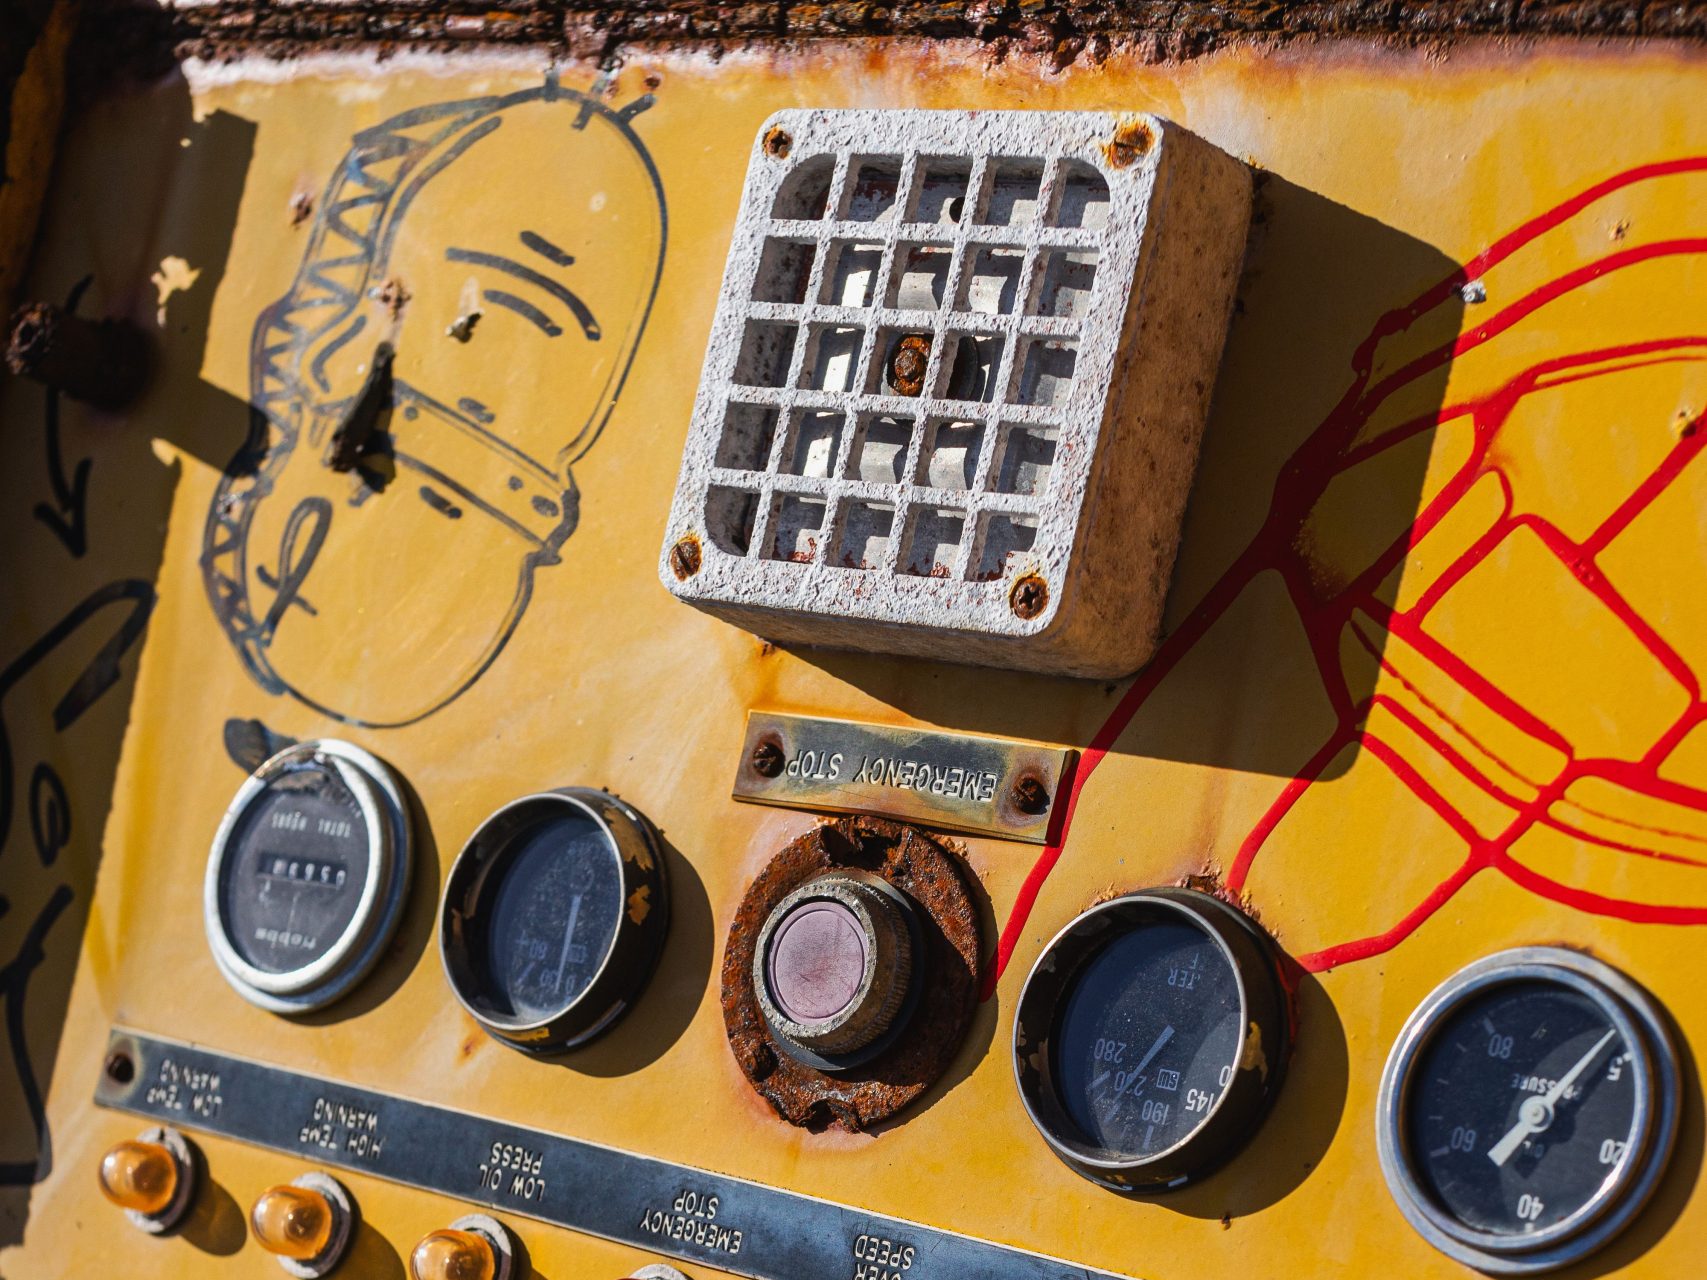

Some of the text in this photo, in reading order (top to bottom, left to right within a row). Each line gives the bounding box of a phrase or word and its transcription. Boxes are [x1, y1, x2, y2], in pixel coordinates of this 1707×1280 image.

[786, 750, 998, 802] EMERGENCY STOP
[1093, 1038, 1127, 1064] 280
[1487, 1034, 1514, 1060] 80
[160, 1058, 220, 1092] WARNING
[1511, 1073, 1582, 1100] PRSSURE
[147, 1085, 222, 1118] LOW TEMP
[313, 1098, 377, 1131] WARNING
[1142, 1101, 1170, 1125] 190
[1185, 1088, 1215, 1114] 145
[299, 1124, 383, 1158] HIGH TEMP
[1452, 1126, 1476, 1153] 60
[1600, 1139, 1626, 1166] 20
[491, 1142, 544, 1175] PRESS
[479, 1164, 545, 1201] LOW OIL
[674, 1191, 718, 1220] STOP
[1517, 1194, 1544, 1220] 40
[640, 1208, 742, 1253] EMERGENCY
[854, 1234, 915, 1271] SPEED
